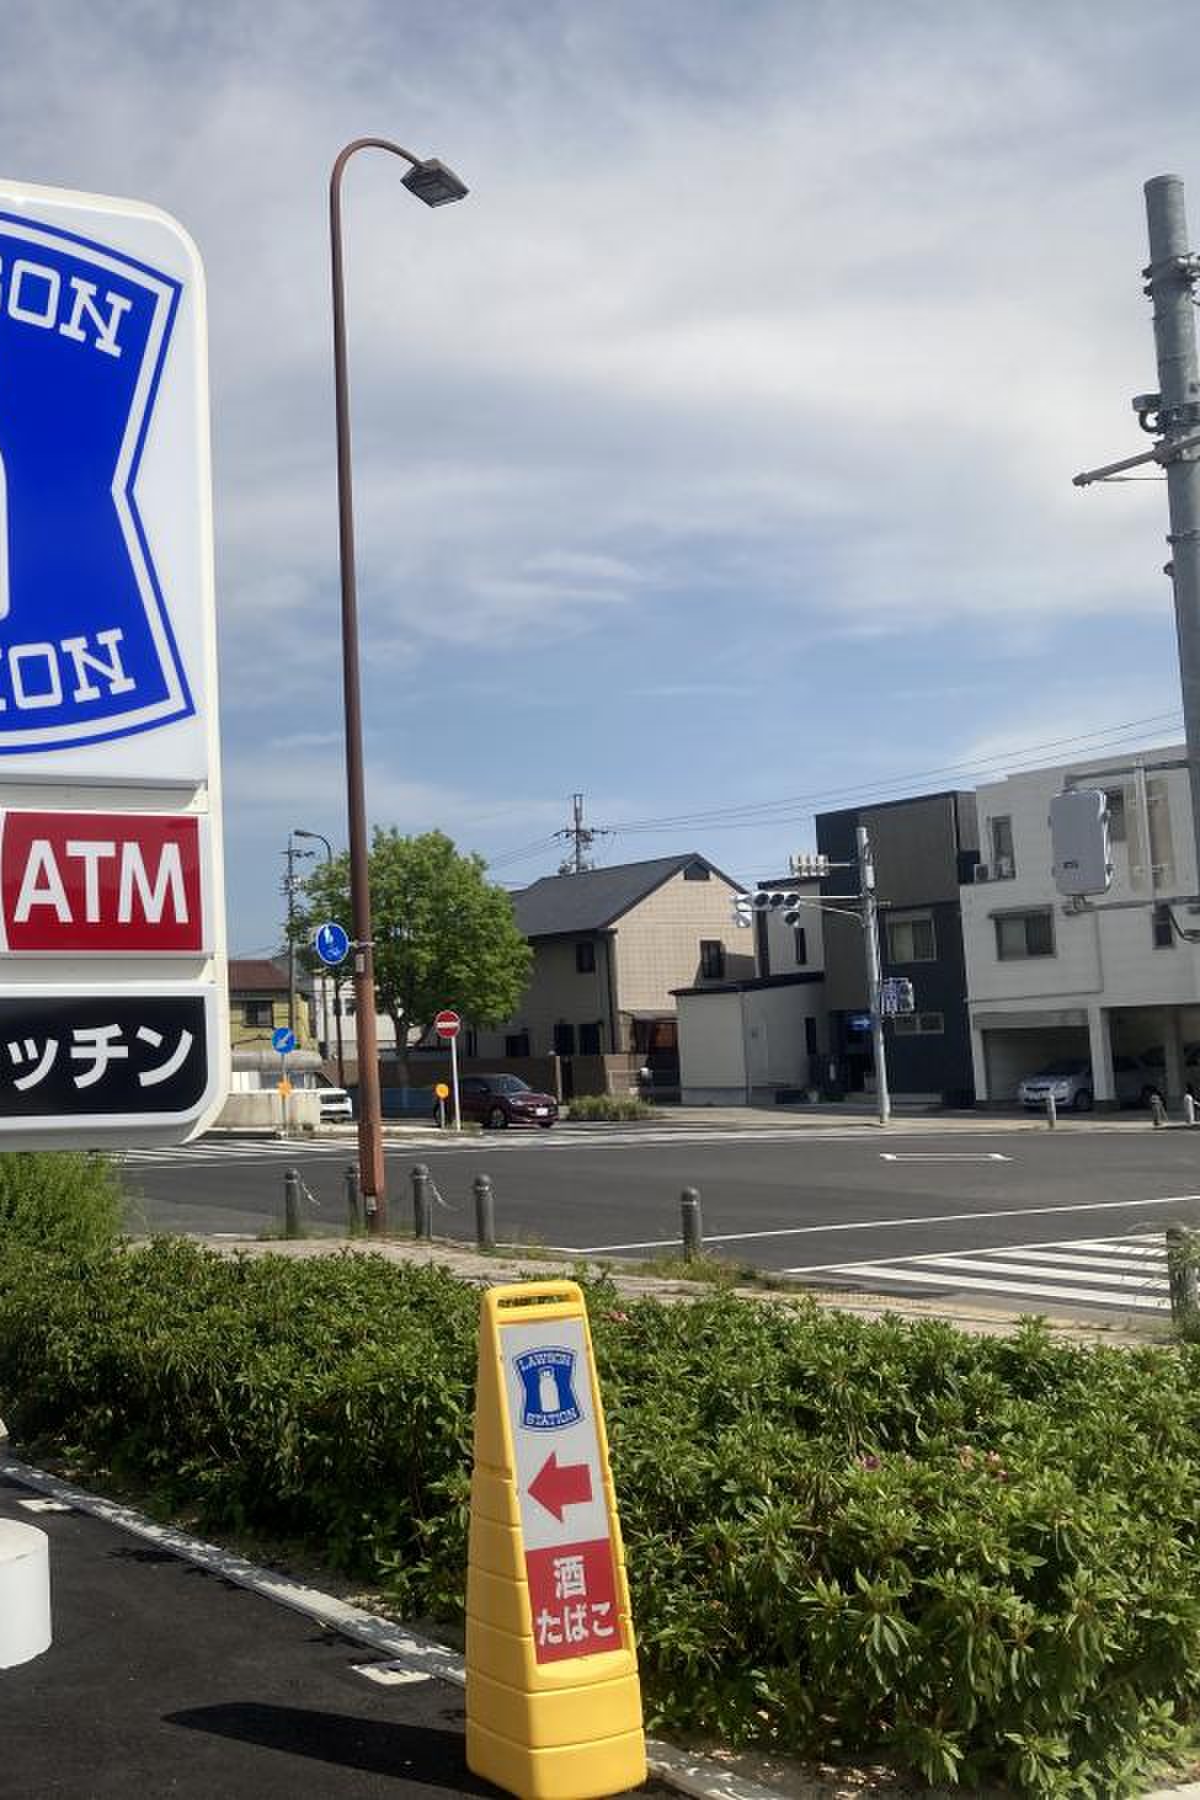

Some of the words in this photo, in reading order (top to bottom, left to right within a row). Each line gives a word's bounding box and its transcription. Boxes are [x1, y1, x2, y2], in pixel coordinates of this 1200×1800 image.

[14, 840, 190, 925] ATM
[526, 1407, 578, 1425] STATION
[553, 1555, 588, 1600] 酒
[537, 1601, 615, 1647] たばこ
